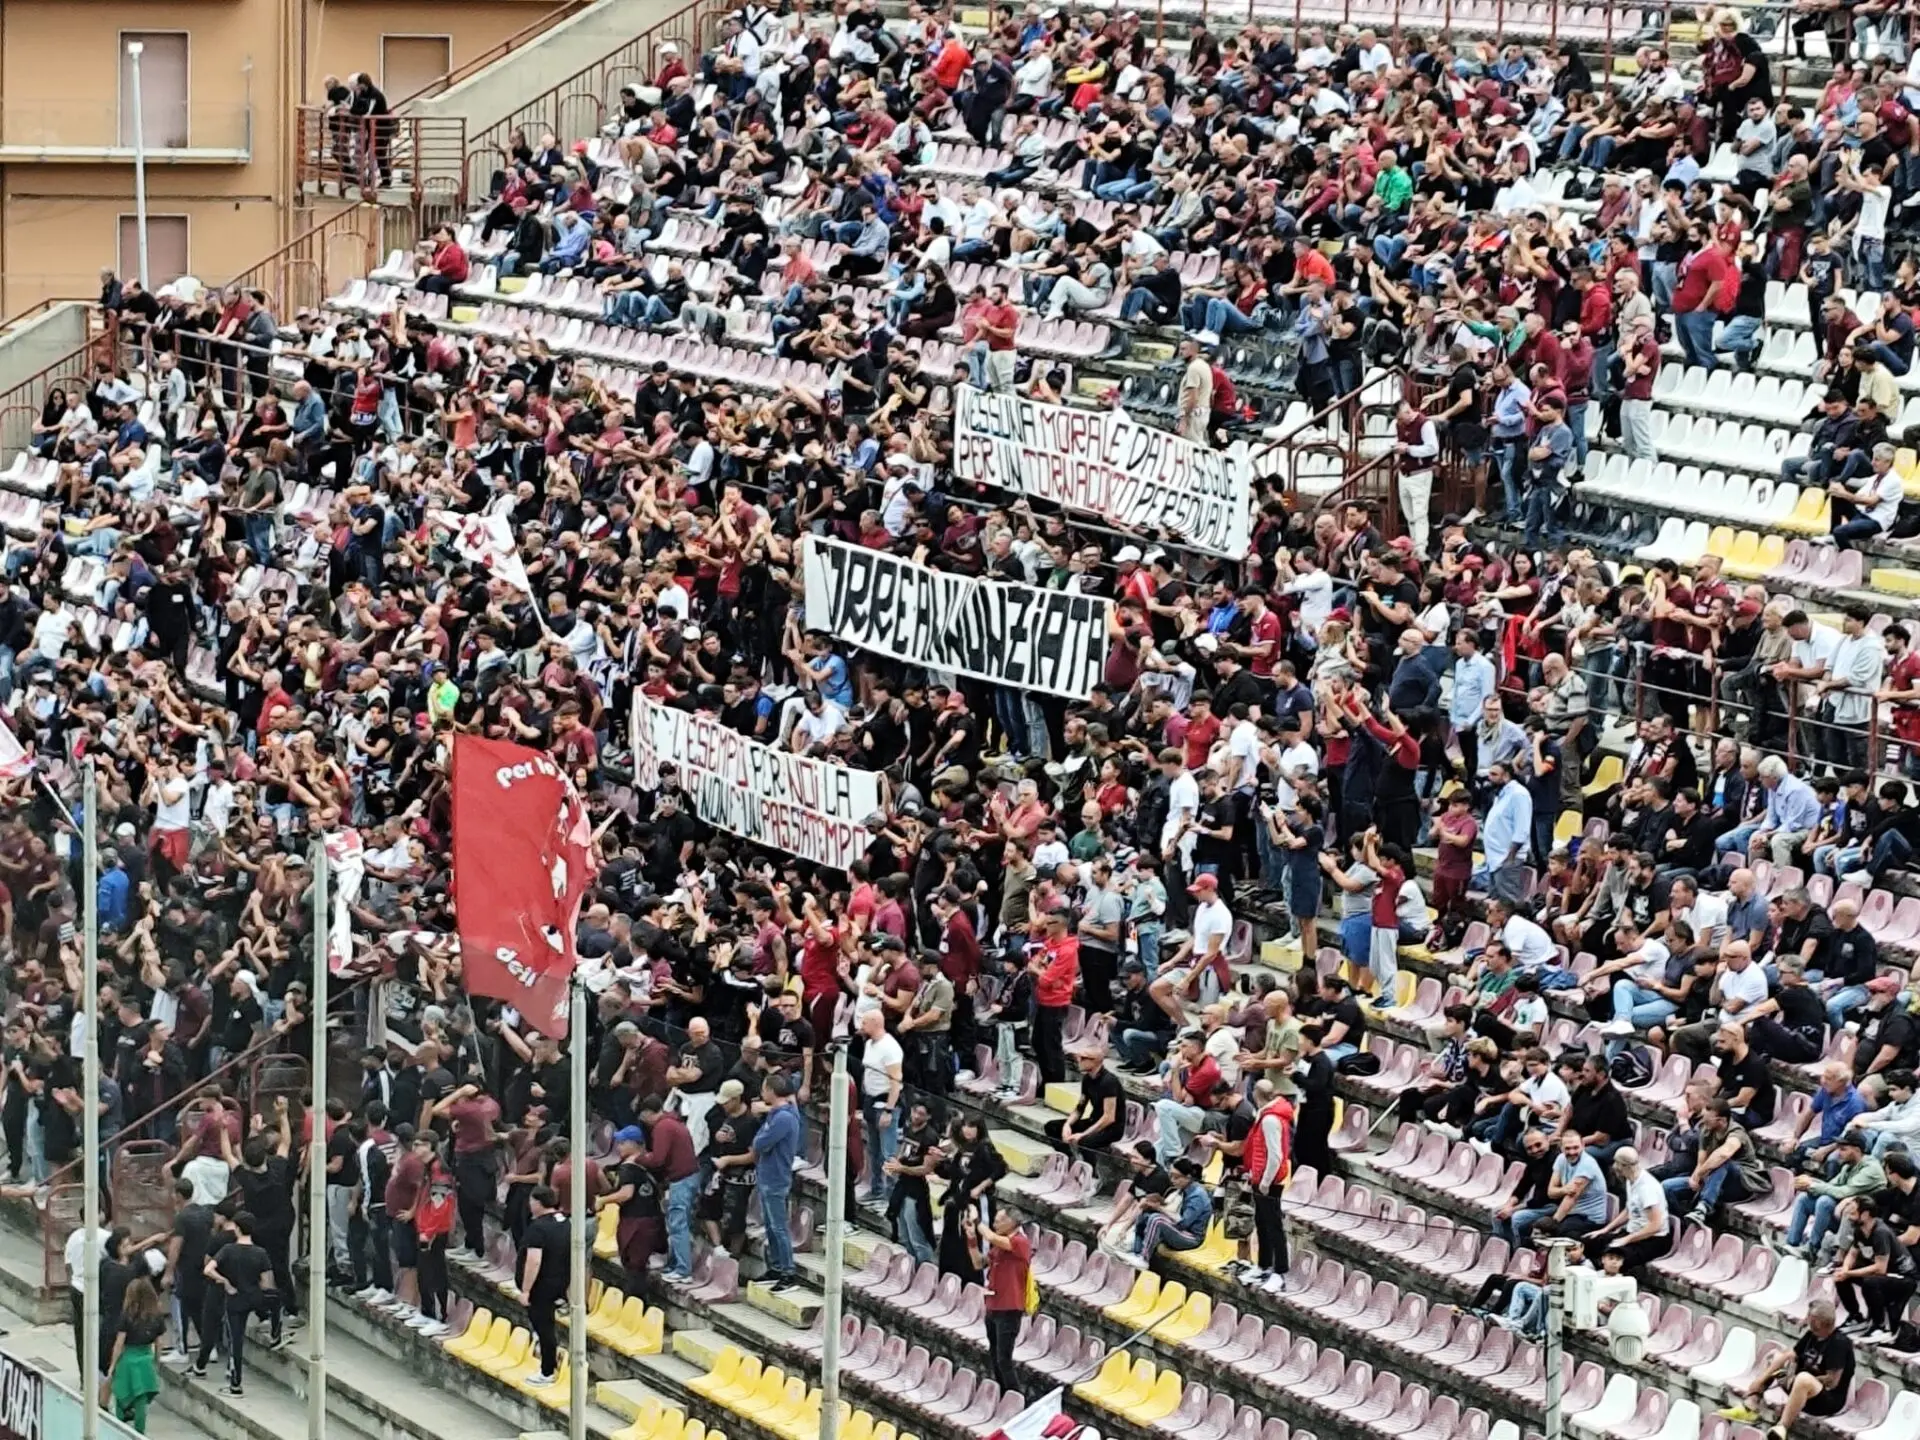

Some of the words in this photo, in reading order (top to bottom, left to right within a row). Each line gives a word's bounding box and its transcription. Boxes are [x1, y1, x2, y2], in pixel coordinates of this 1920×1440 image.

[961, 388, 1037, 447] NESSUNA
[1040, 408, 1129, 466] MORALE
[1158, 438, 1190, 489] CHI
[960, 434, 995, 479] PER
[998, 443, 1023, 490] UN
[1128, 481, 1233, 552] PERSONALE
[700, 774, 728, 826] NON
[749, 745, 785, 796] PER
[824, 763, 852, 818] LA
